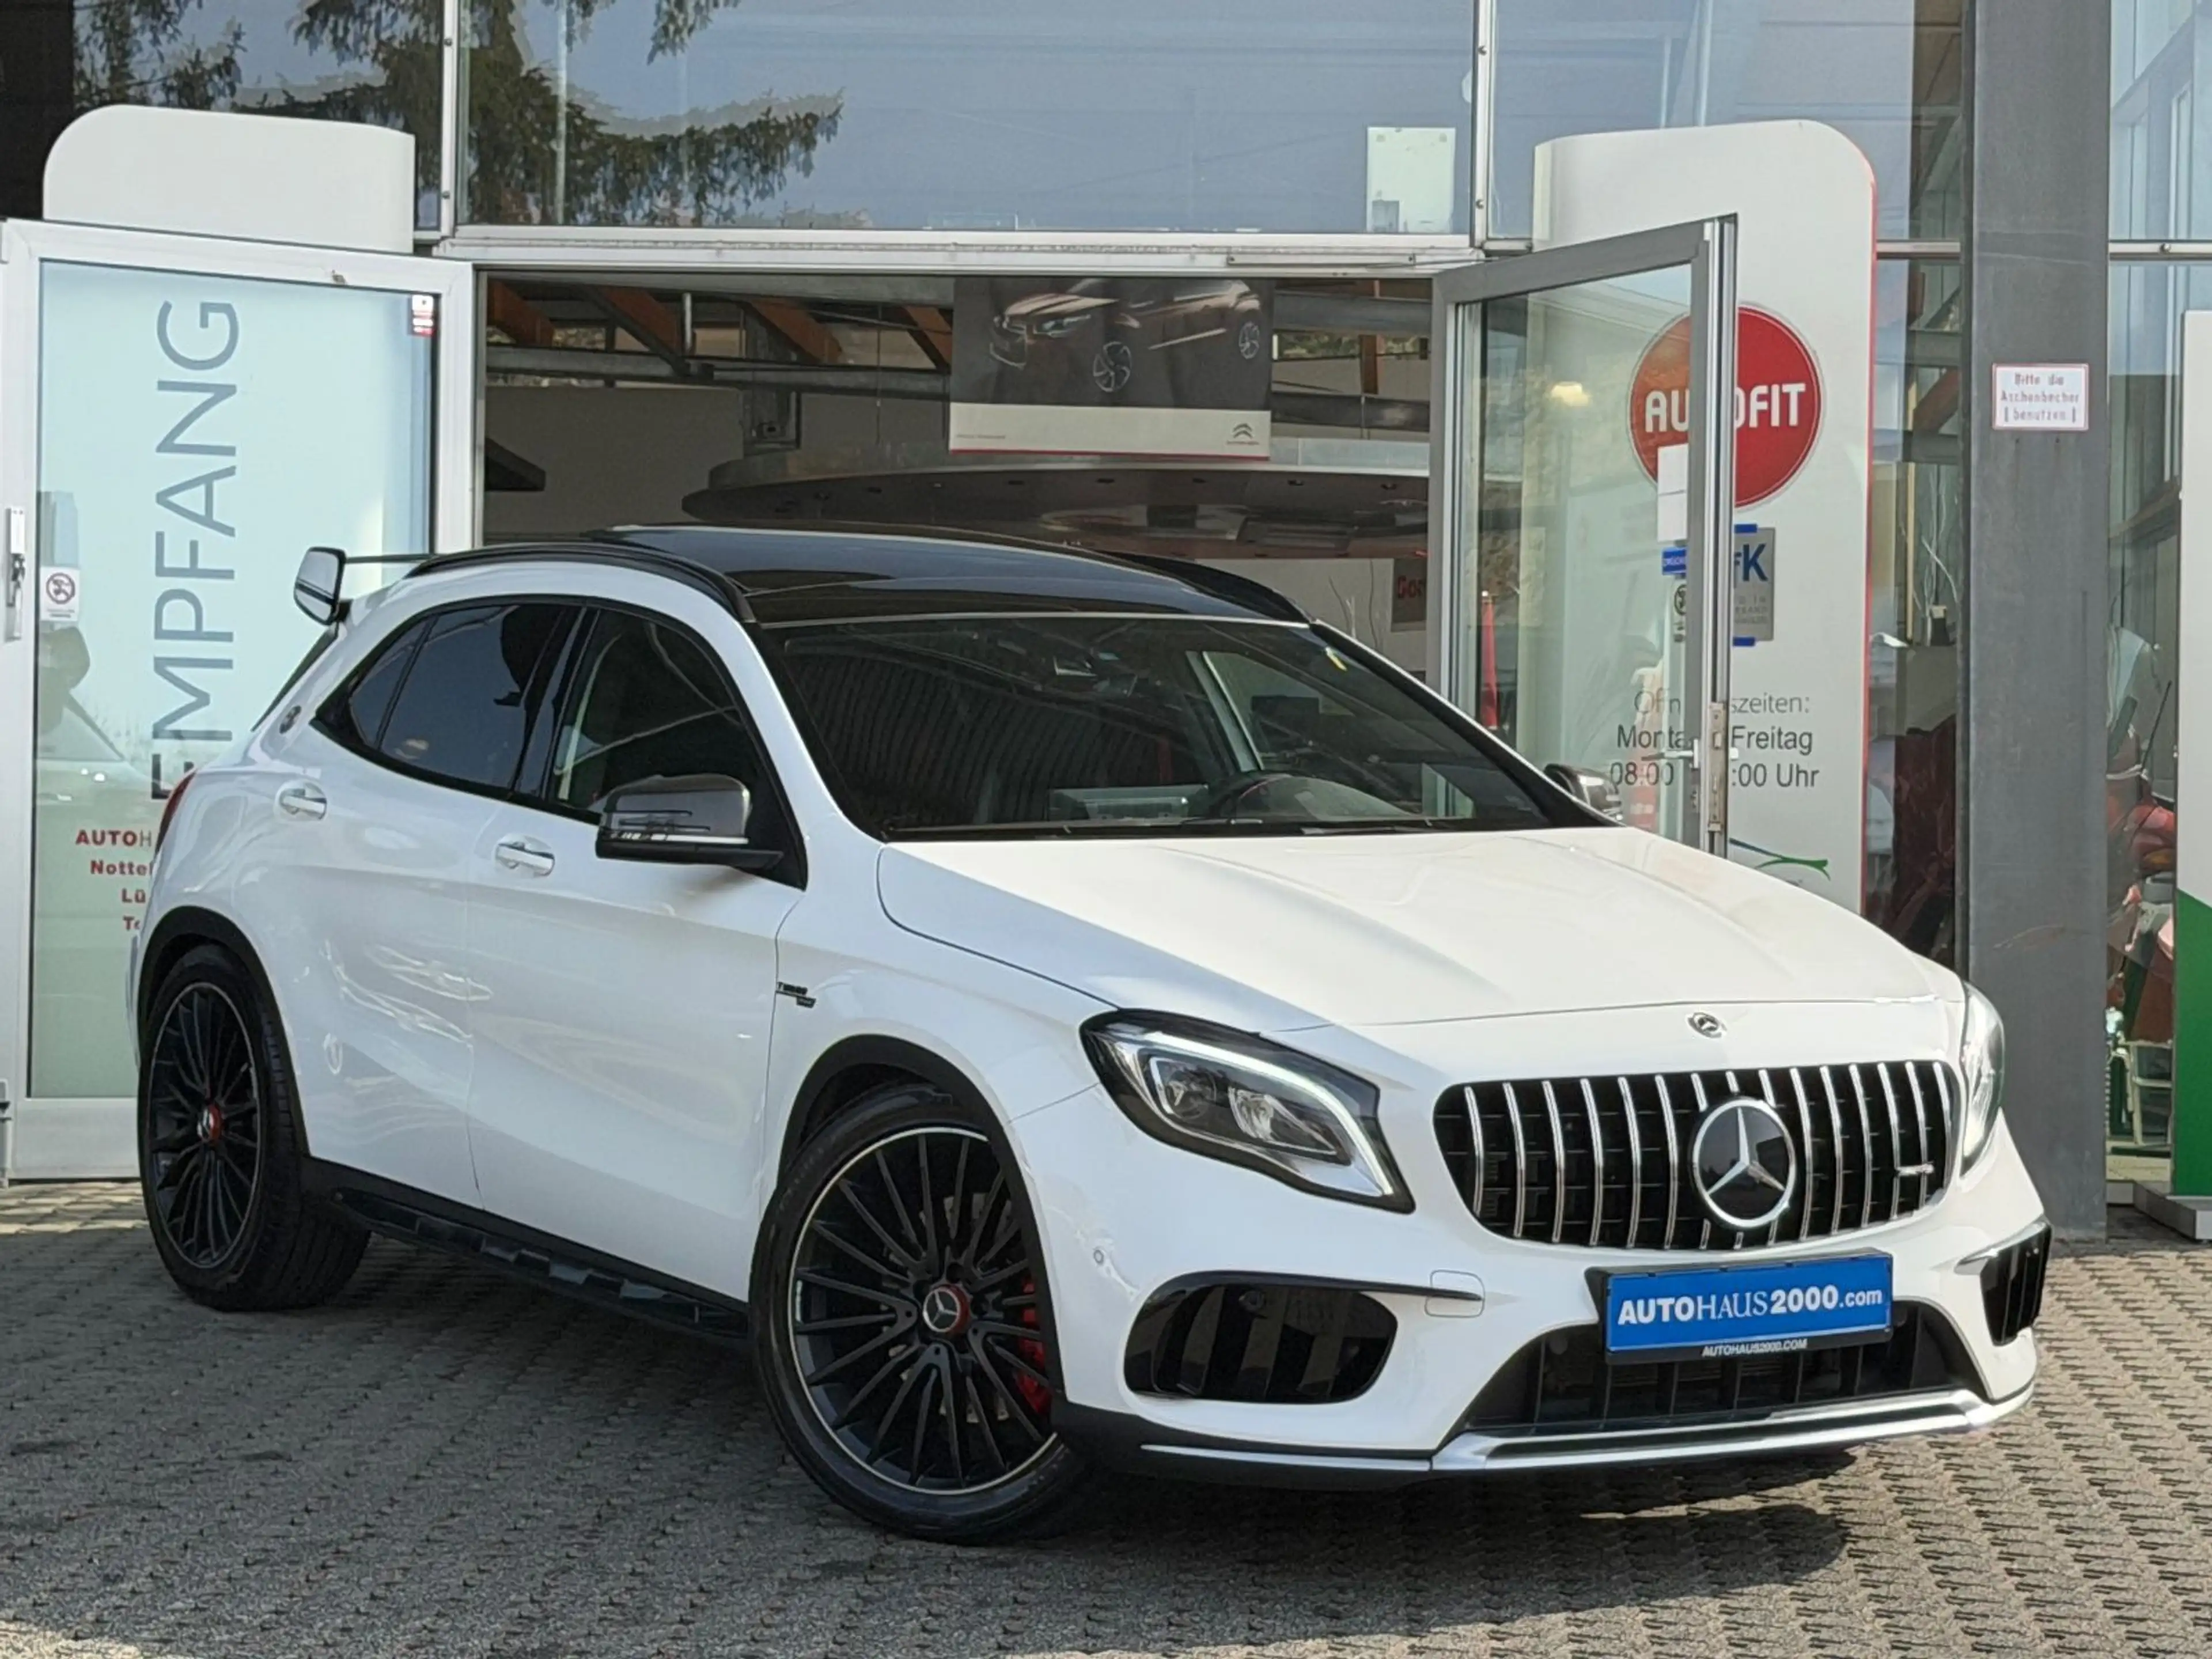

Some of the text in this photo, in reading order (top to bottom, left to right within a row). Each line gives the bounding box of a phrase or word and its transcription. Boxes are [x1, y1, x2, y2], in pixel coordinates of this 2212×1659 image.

[1731, 725, 1813, 756] Freitag
[1776, 763, 1820, 787] Uhr
[75, 830, 152, 847] AUTOH
[1617, 1284, 1883, 1325] AUTOHAUS2000.com
[1701, 1338, 1809, 1358] AUTOHAUS2000.COM
